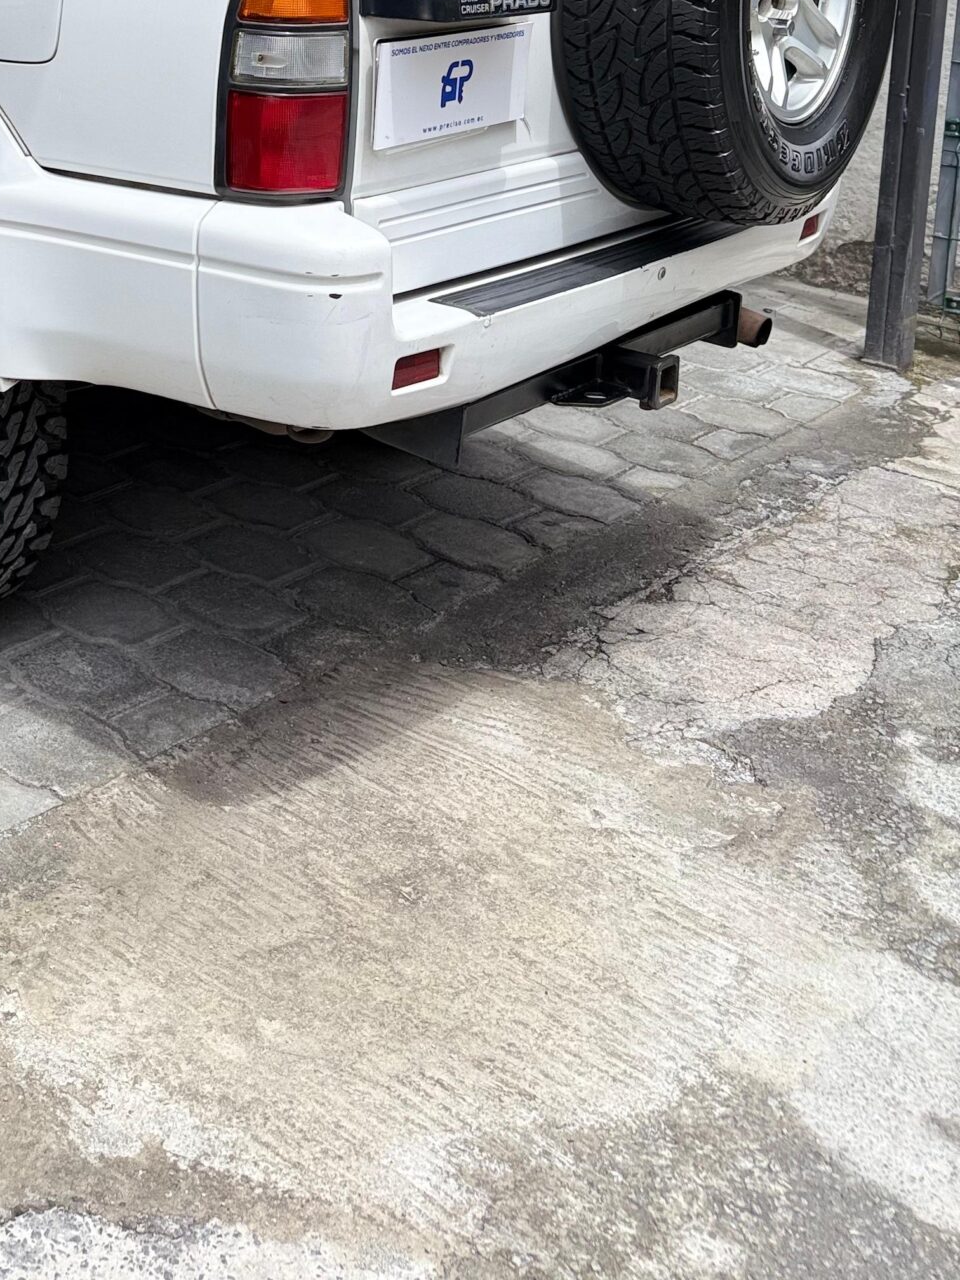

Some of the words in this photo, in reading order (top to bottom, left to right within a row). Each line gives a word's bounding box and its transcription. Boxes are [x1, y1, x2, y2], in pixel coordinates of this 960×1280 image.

[461, 3, 490, 14] CRUISER
[391, 47, 411, 57] SOMOS
[411, 46, 418, 54] EL
[419, 43, 433, 53] NEXO
[434, 40, 451, 51] ENTRE
[451, 35, 490, 48] COMPRADORES
